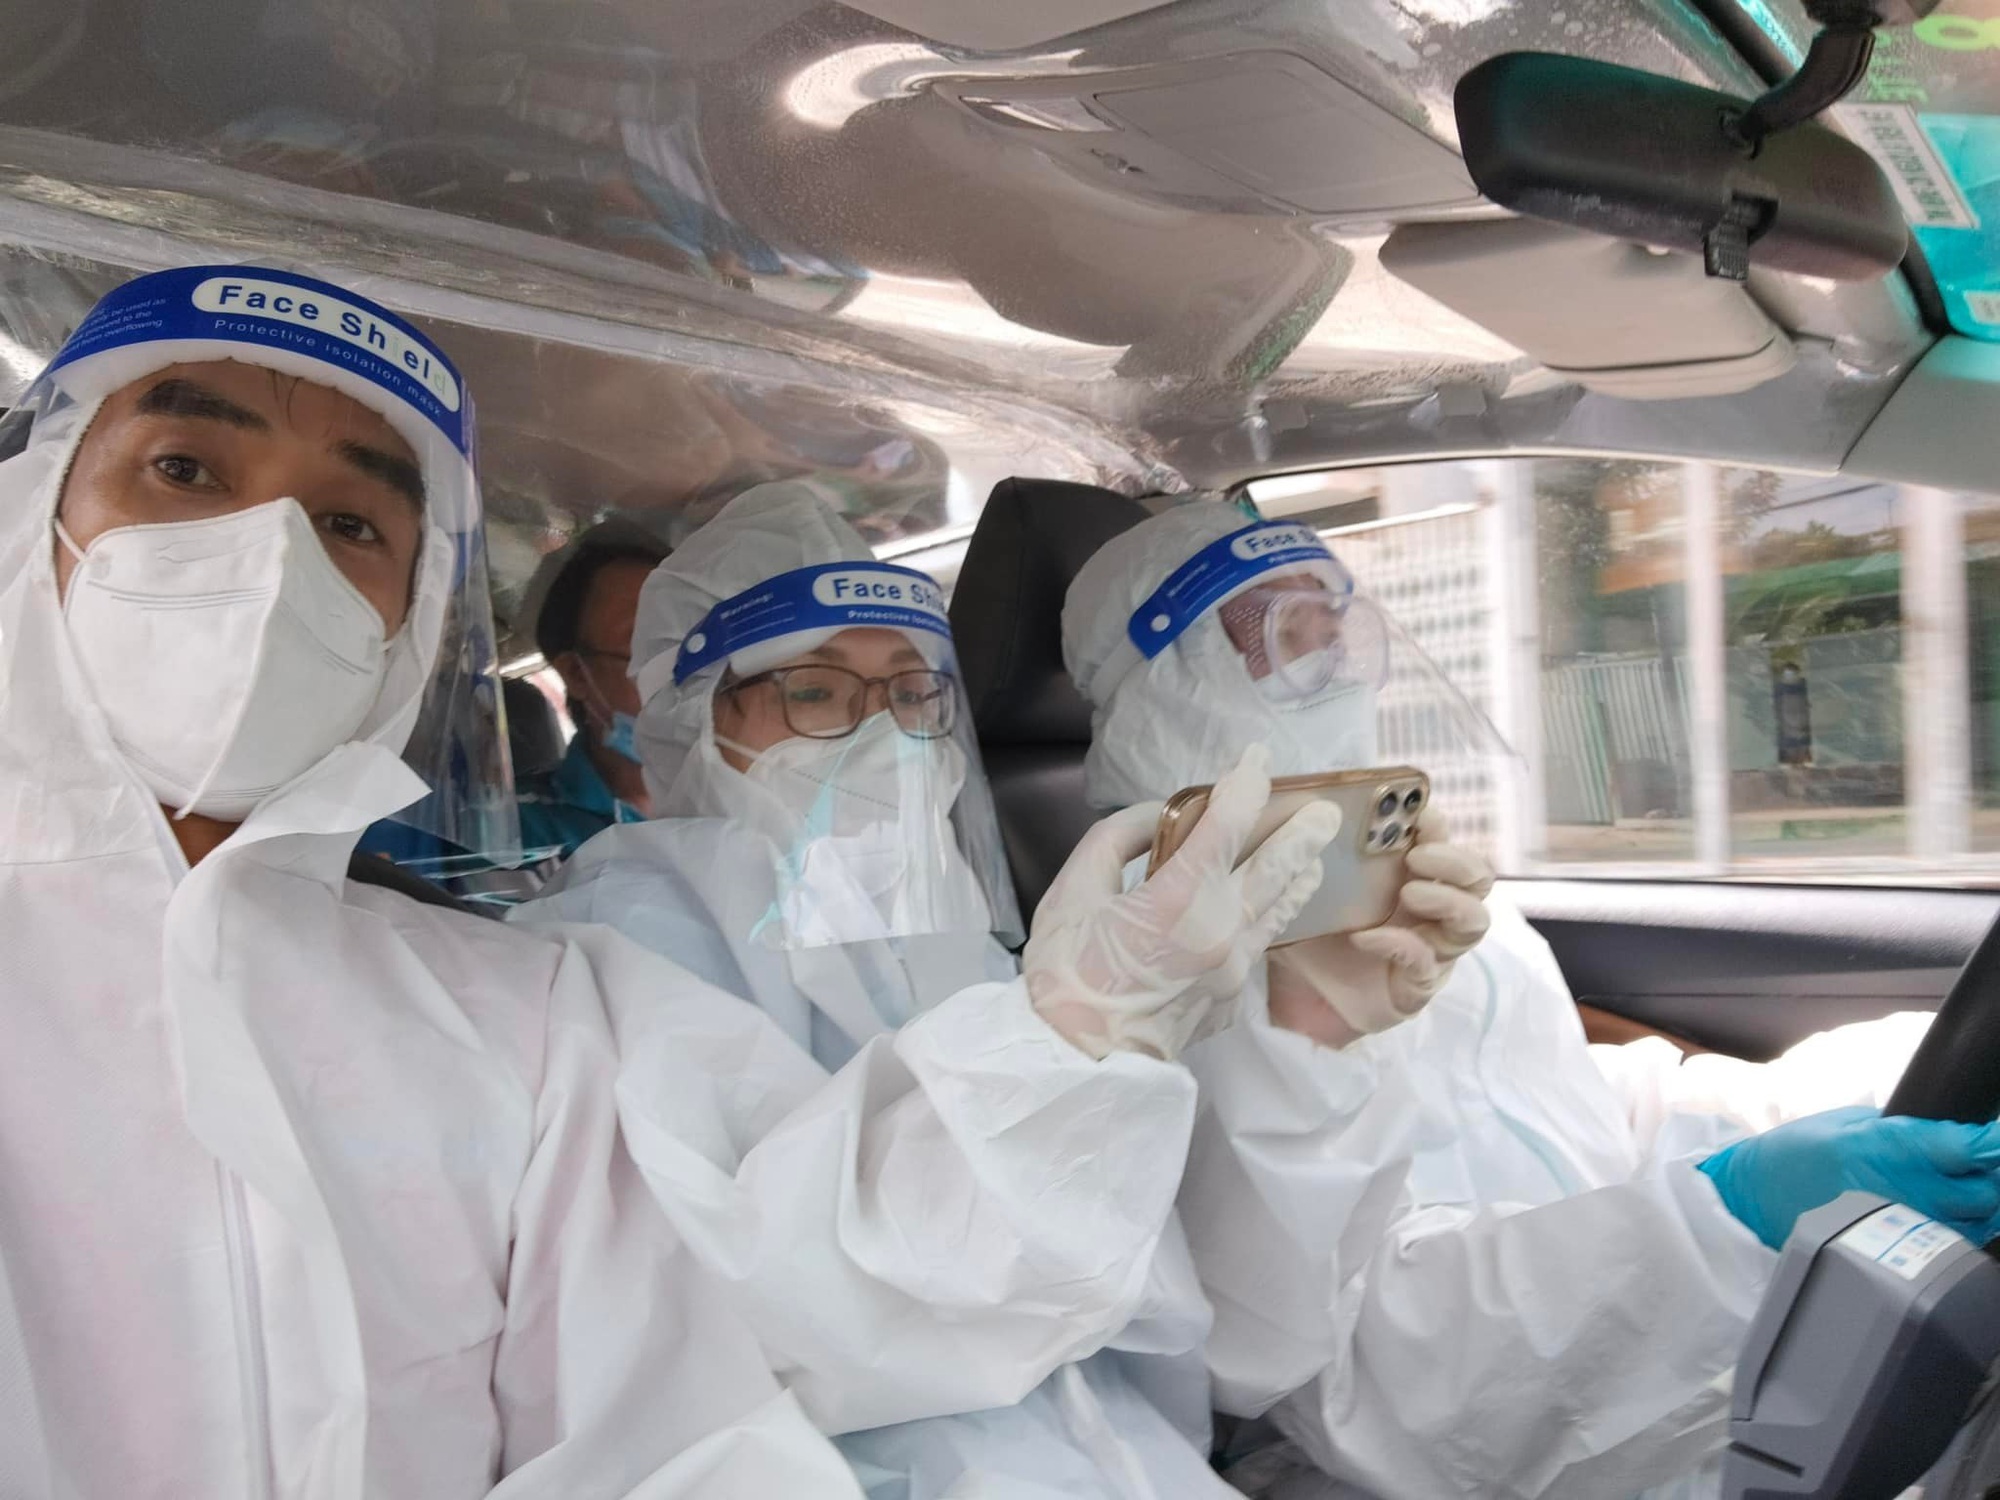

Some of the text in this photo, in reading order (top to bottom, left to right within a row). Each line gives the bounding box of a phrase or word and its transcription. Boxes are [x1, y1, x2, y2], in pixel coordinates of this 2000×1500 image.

[219, 285, 319, 320] Face
[104, 319, 163, 337] overflowing
[215, 320, 440, 417] Protective isolation mask
[832, 579, 902, 600] Face
